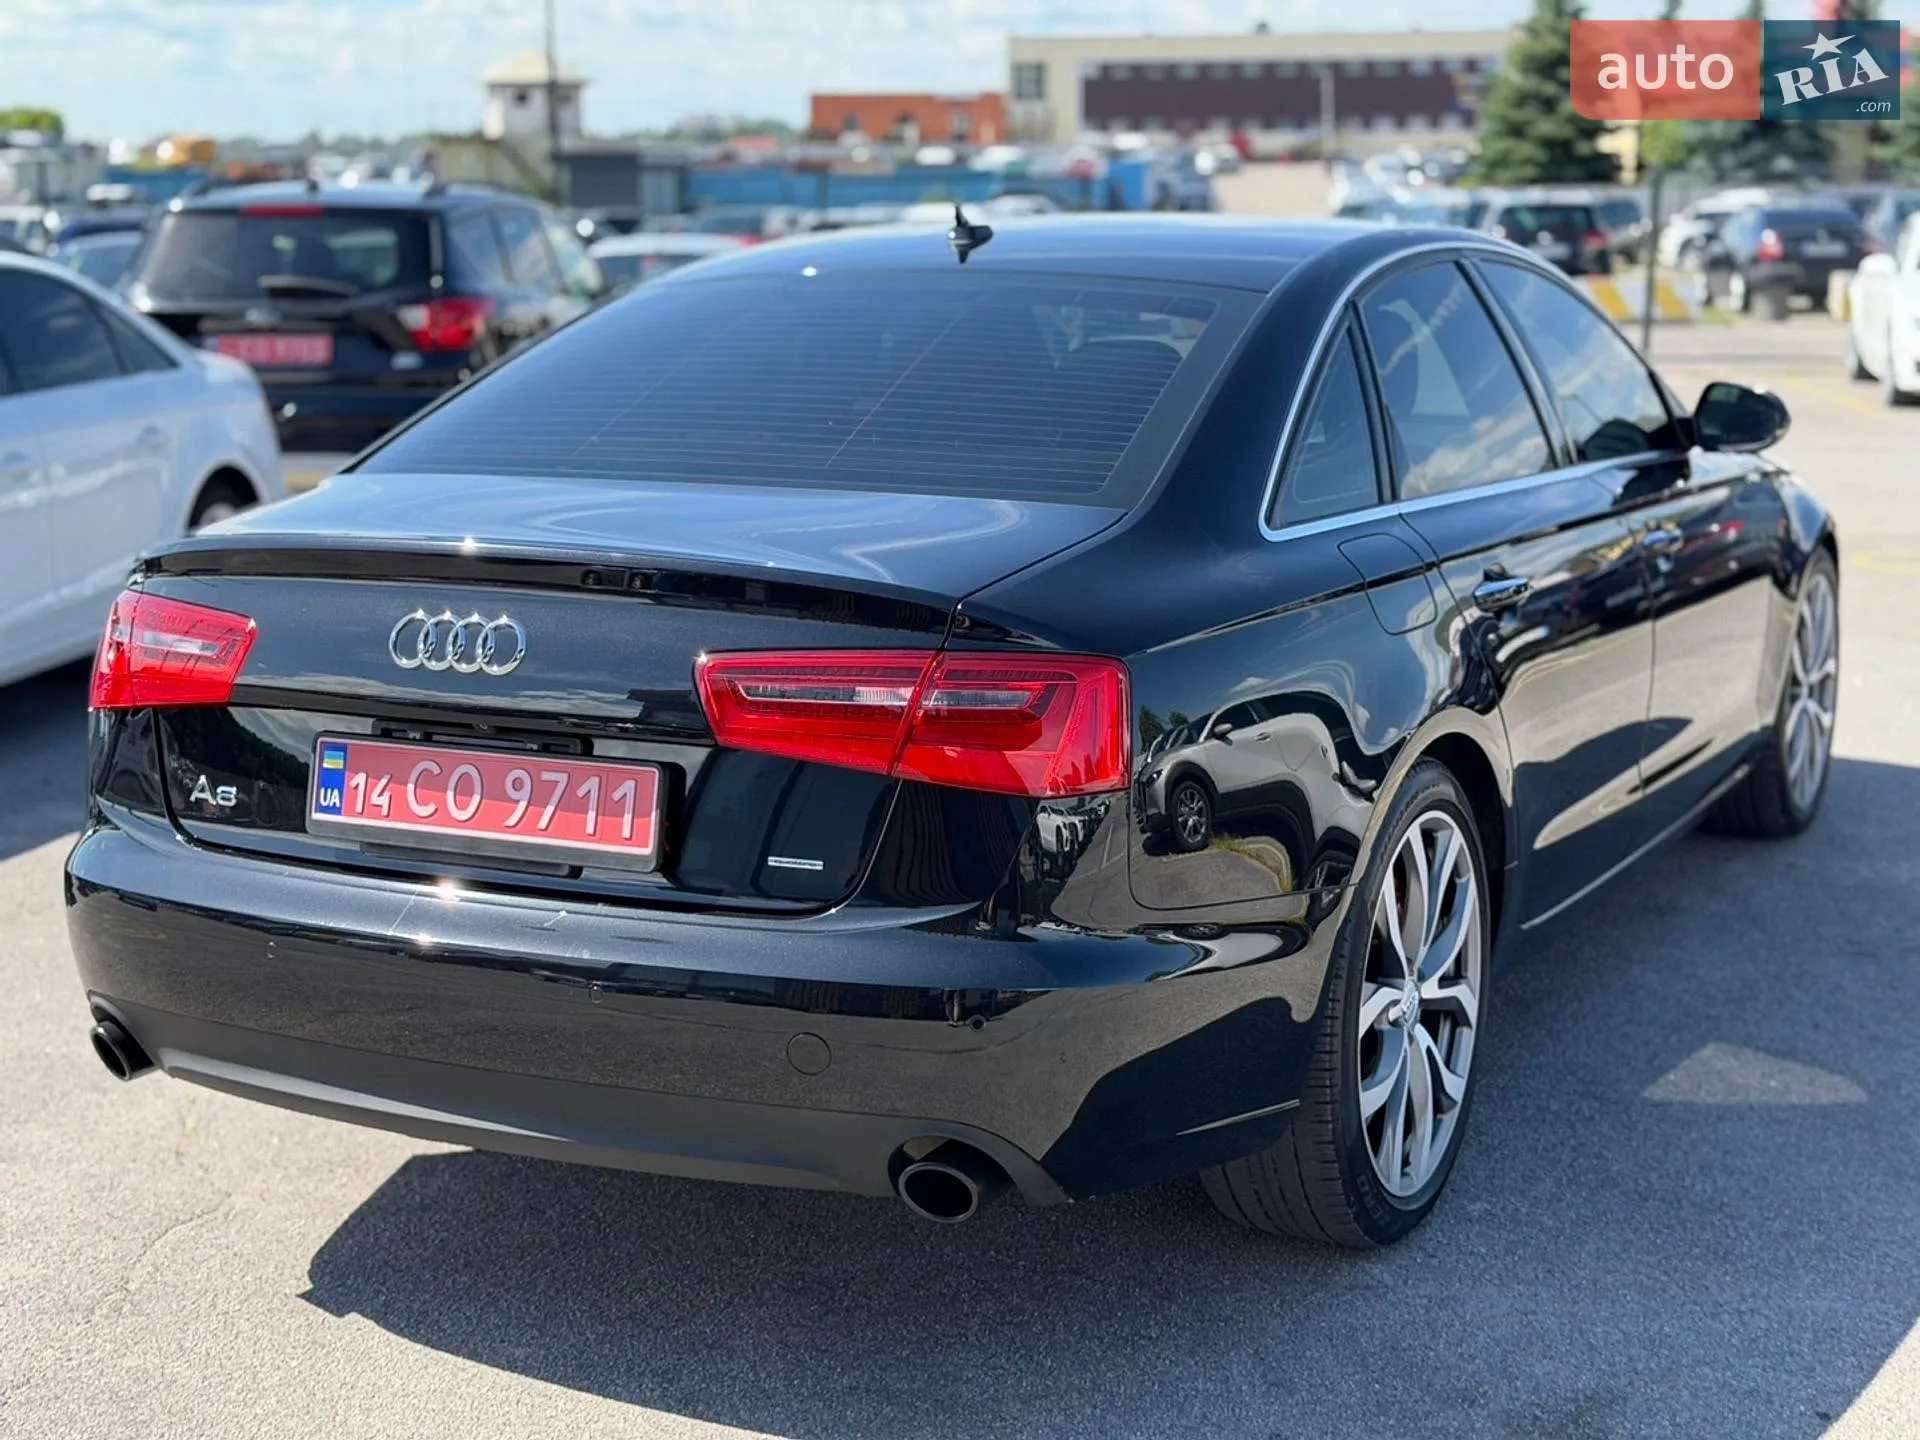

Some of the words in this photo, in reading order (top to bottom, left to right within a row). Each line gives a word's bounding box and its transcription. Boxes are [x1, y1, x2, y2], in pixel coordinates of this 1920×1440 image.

[319, 786, 341, 808] UA
[348, 772, 392, 817] 14
[406, 760, 484, 822] CO
[503, 768, 638, 840] 9711
